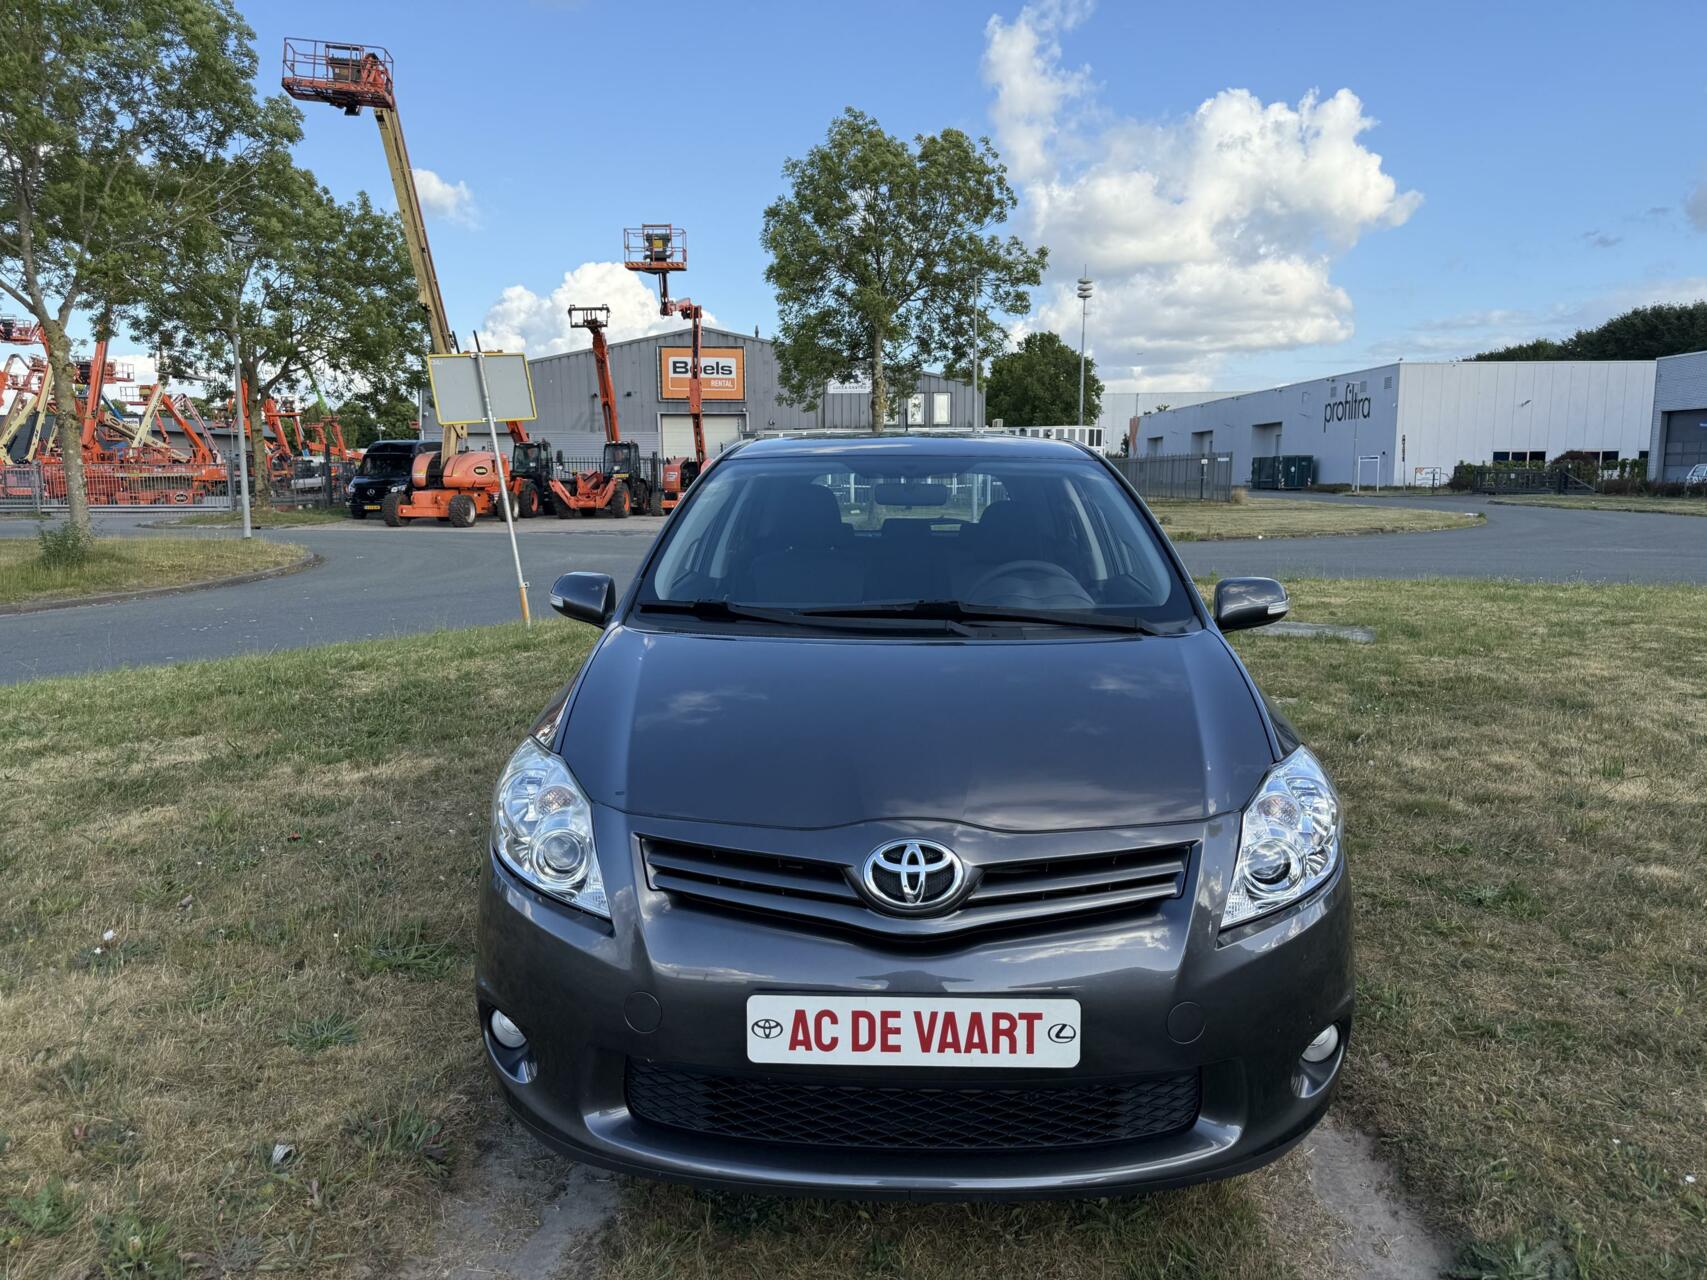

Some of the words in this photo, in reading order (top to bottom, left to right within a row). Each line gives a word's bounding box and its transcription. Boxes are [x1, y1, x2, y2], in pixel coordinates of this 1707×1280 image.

[710, 380, 734, 388] RENTAL
[1323, 383, 1371, 433] profiltra
[788, 1009, 839, 1052] AC
[851, 1010, 902, 1053] DE
[913, 1011, 1043, 1054] VAART
